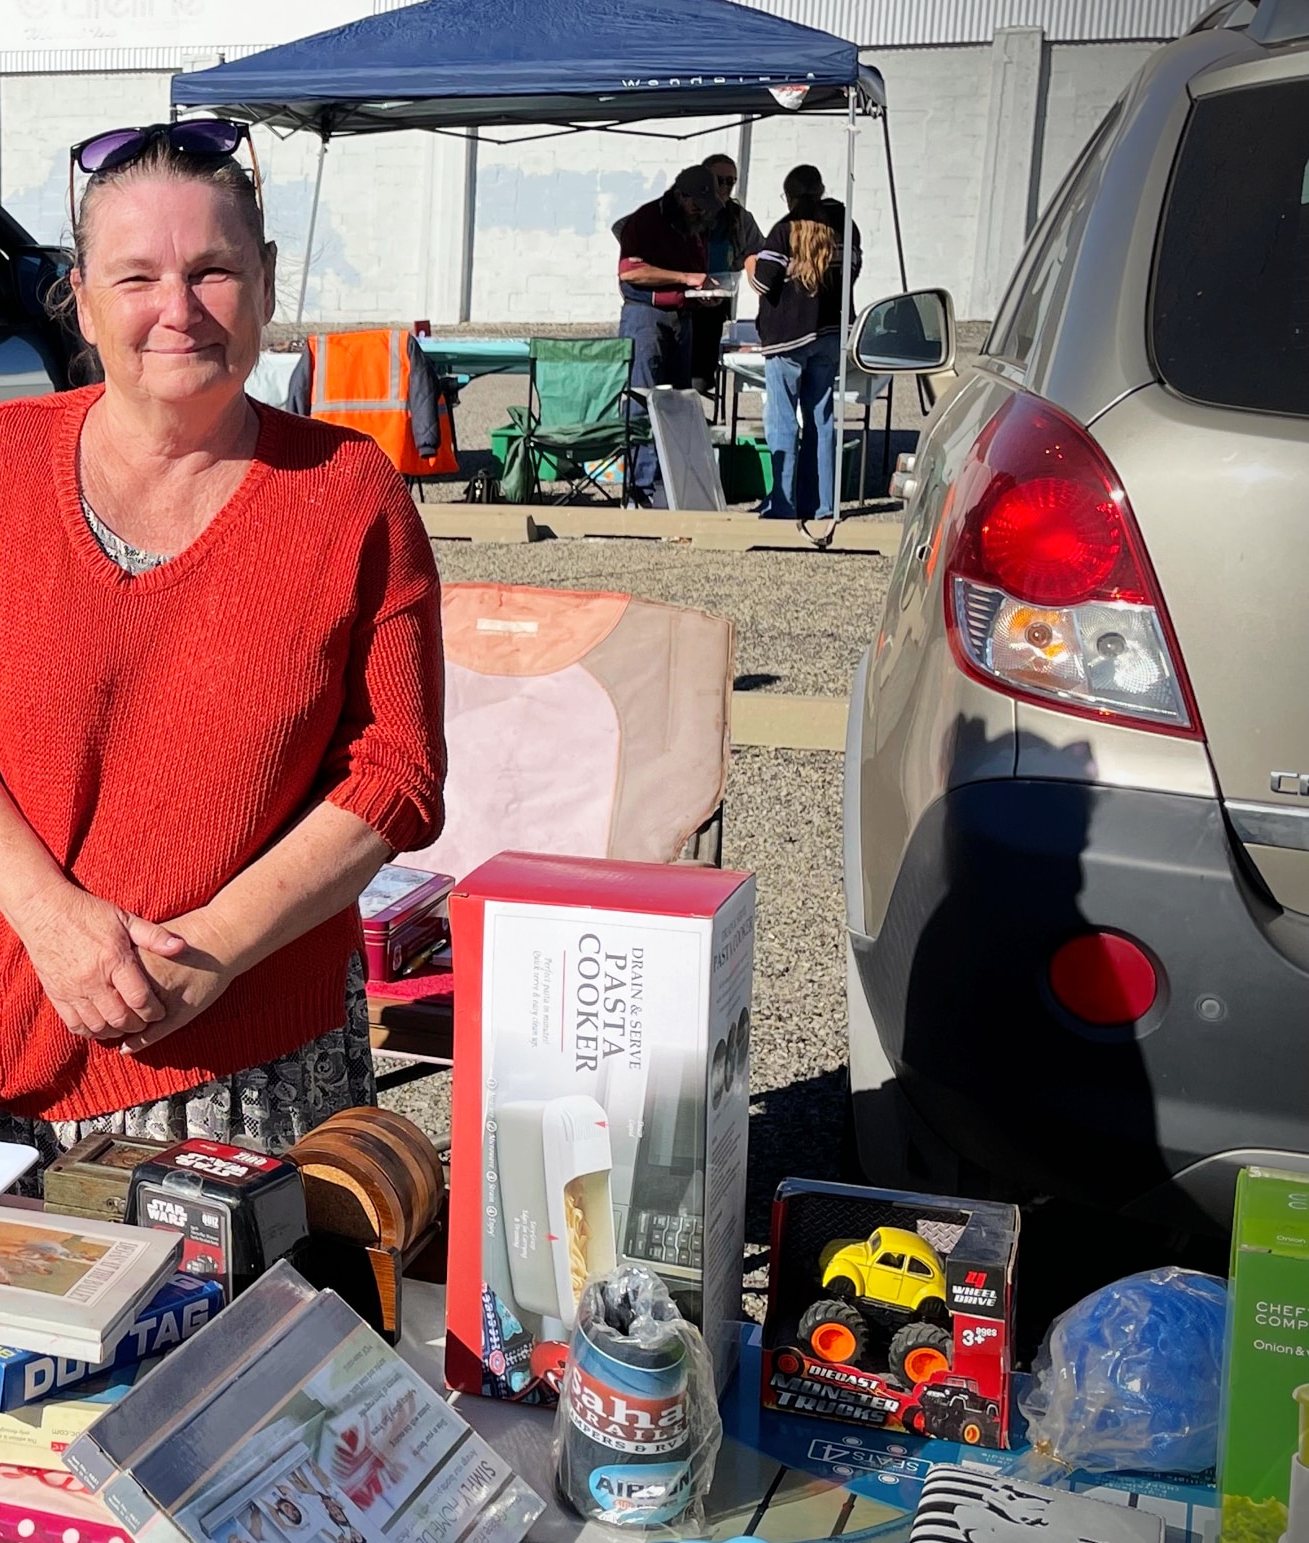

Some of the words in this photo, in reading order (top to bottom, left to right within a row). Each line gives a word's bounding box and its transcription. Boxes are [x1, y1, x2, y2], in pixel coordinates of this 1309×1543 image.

[631, 947, 645, 1001] DRAIN
[574, 933, 603, 1074] COOKER
[601, 950, 629, 1060] PASTA
[630, 1005, 642, 1016] &
[628, 1021, 643, 1071] SERVE
[233, 1151, 268, 1167] QUIZ
[147, 1204, 187, 1227] WARS
[150, 1199, 187, 1217] STAR
[201, 1212, 220, 1229] QUIZ
[952, 1285, 997, 1299] WHEEL
[964, 1271, 988, 1289] 4
[953, 1294, 997, 1308] DRIVE
[1256, 1301, 1309, 1317] CHEF'
[129, 1298, 210, 1357] TAG
[976, 1326, 997, 1338] ages
[1253, 1339, 1294, 1356] Onion
[808, 1364, 880, 1391] DIECAST
[572, 1366, 685, 1429] Saha
[770, 1372, 901, 1414] MONSTER
[574, 1397, 688, 1441] TRAILE
[776, 1391, 887, 1424] TRUCKS
[569, 1407, 627, 1451] AMPERS
[823, 1442, 852, 1463] 4
[852, 1450, 920, 1472] SEATS
[453, 1459, 498, 1506] SIMPLY
